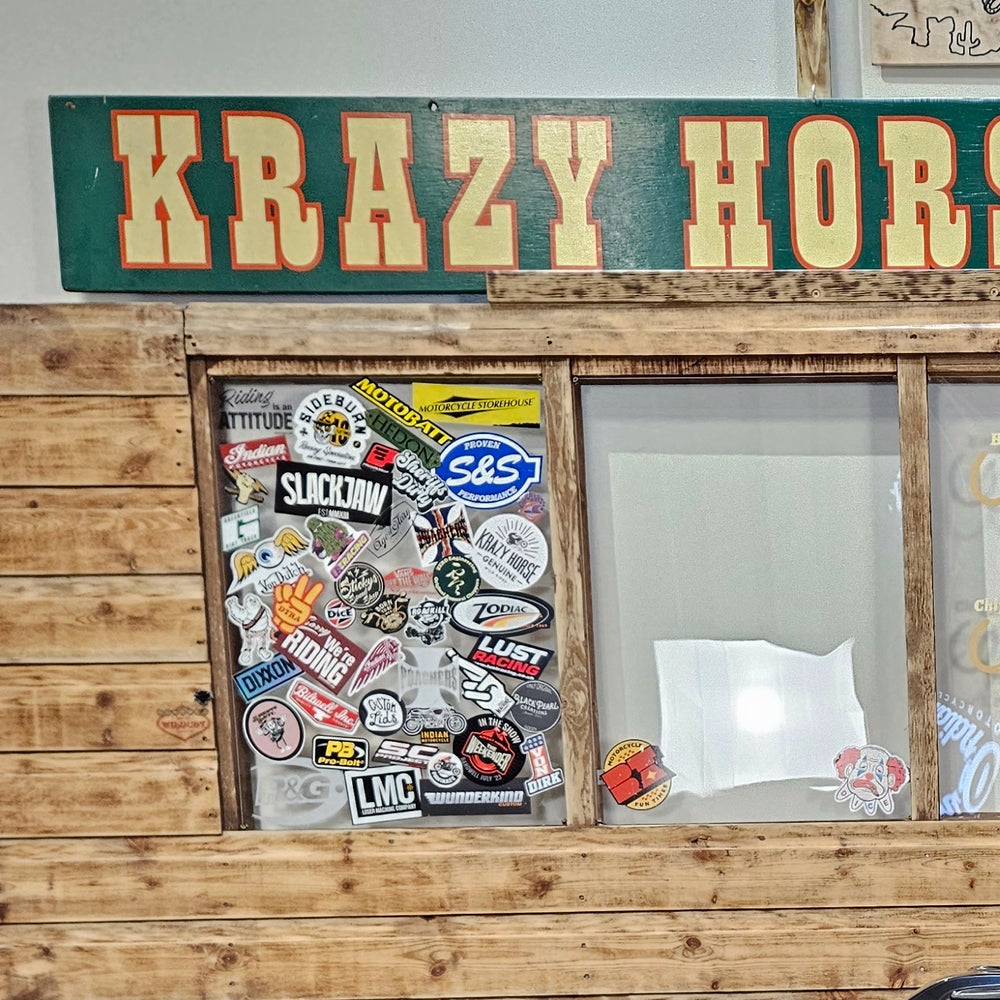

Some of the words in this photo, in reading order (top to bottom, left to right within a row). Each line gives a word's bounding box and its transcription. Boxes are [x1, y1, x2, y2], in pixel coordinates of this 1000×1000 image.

[110, 109, 613, 271] KRAZY
[222, 387, 275, 408] Riding
[418, 401, 476, 413] MOTORCYCLE
[477, 398, 533, 410] STOREHOUSE
[219, 411, 293, 430] ATTITUDE
[299, 393, 366, 434] SIDEBURN
[355, 378, 453, 445] MOTOBATT
[372, 414, 434, 463] HEDON
[463, 439, 501, 451] PROVEN
[223, 443, 287, 464] Indian
[446, 454, 523, 487] S&S
[280, 471, 388, 515] SLACKJAW
[457, 485, 518, 502] PERFORMANCE
[475, 528, 510, 559] KRAZY
[506, 552, 540, 584] HORSE
[482, 555, 517, 581] GENUINE
[275, 561, 306, 581] Dutch
[472, 602, 529, 624] ZODIAC
[281, 629, 349, 687] RIDING
[324, 635, 356, 667] We're
[477, 635, 548, 664] LUST
[241, 657, 296, 693] DIXXON
[472, 650, 541, 676] RACING
[478, 717, 487, 727] IN
[488, 717, 503, 730] THE
[503, 722, 522, 744] SHOW
[318, 756, 361, 767] Pro-Bolt
[325, 740, 355, 758] PB
[378, 740, 439, 760] SC
[466, 735, 512, 771] WEEKENDER
[608, 742, 643, 766] MOTORCYCLE
[356, 773, 415, 809] LMC
[527, 771, 562, 794] DIRK
